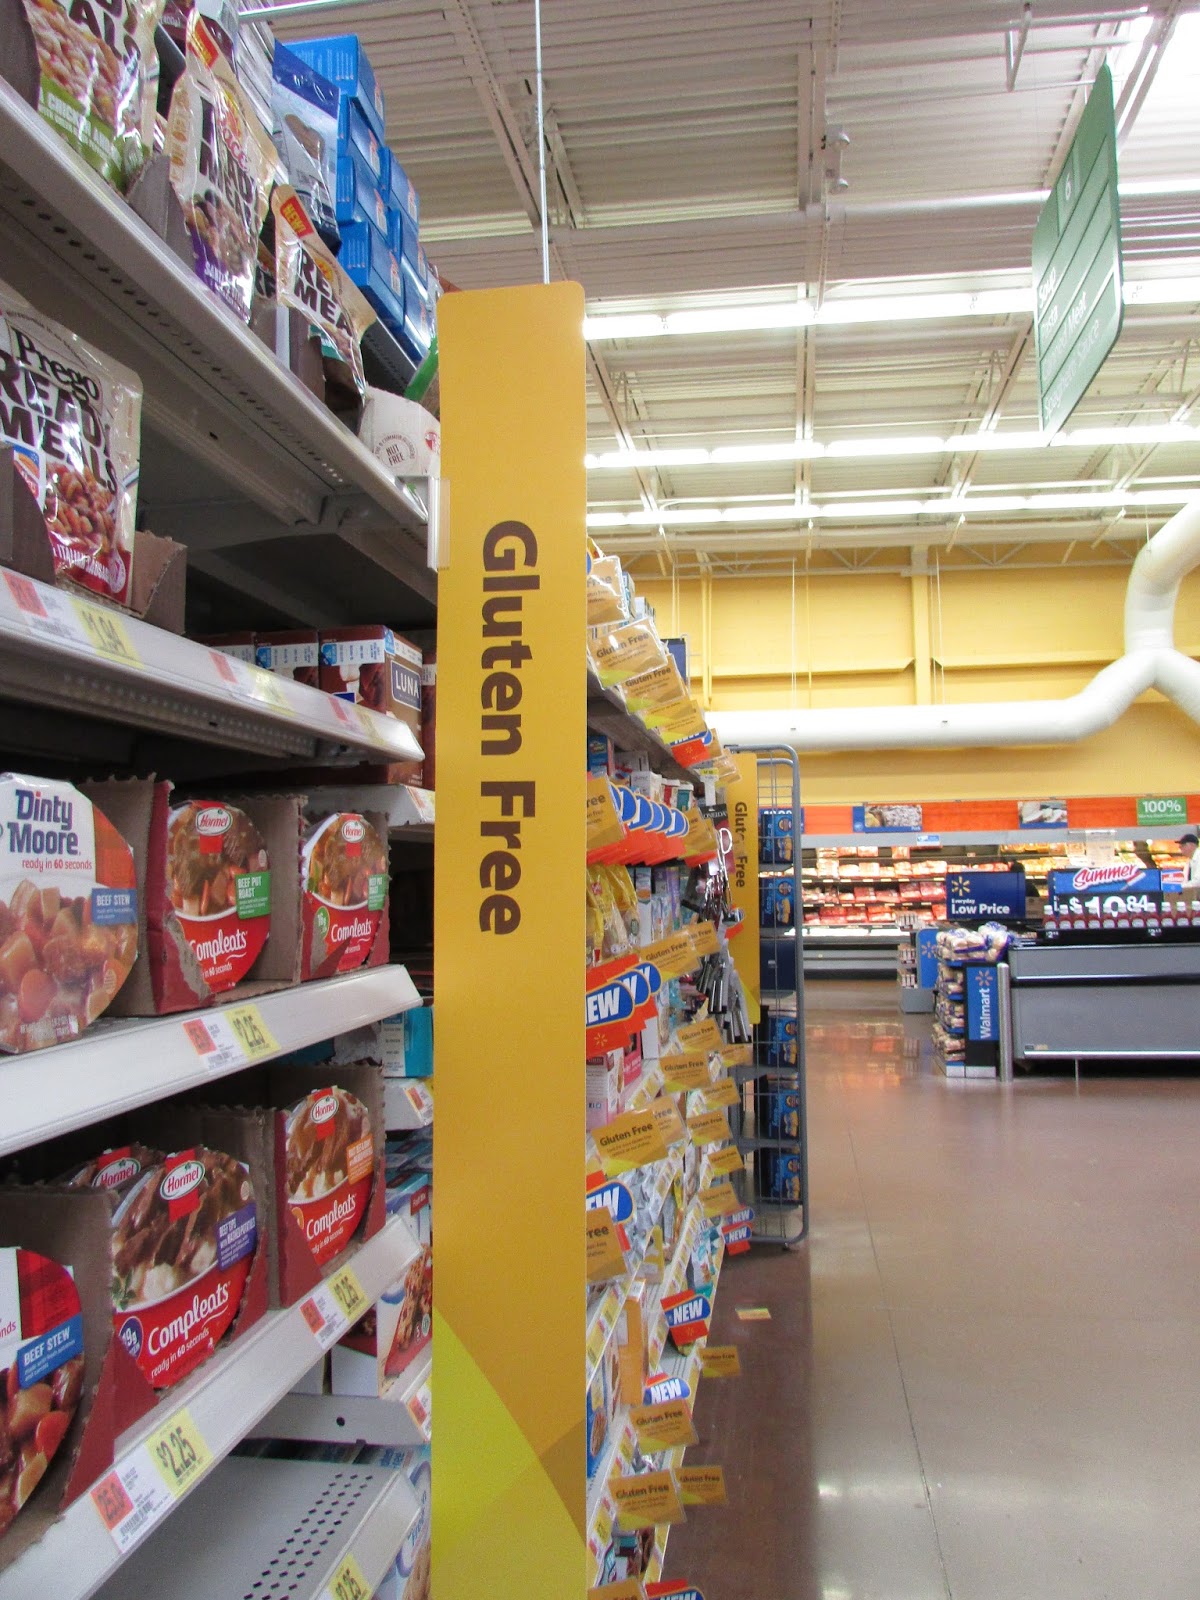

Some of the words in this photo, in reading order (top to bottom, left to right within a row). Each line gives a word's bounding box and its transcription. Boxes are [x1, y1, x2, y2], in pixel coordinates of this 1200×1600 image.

[1067, 291, 1087, 334] Meat
[10, 325, 101, 405] Prego
[385, 444, 400, 457] NUT
[388, 453, 405, 466] FREE
[481, 520, 540, 755] Gluten
[597, 640, 627, 659] Gluten
[628, 632, 649, 646] Free
[395, 670, 420, 699] LUNA
[625, 673, 653, 688] Gluten
[653, 666, 672, 680] Free
[15, 789, 73, 830] Dinty
[587, 793, 606, 808] ree
[1142, 800, 1182, 813] 100%
[199, 814, 229, 828] Hormel
[345, 825, 363, 838] Hormel
[735, 801, 748, 840] Glut
[7, 822, 79, 855] Moore
[22, 857, 44, 873] ready
[45, 857, 53, 869] in
[53, 858, 64, 869] 60
[65, 857, 93, 870] seconds
[479, 781, 536, 934] Free
[735, 856, 748, 888] Free
[1073, 863, 1140, 890] Summer
[96, 895, 112, 906] BEEF
[113, 894, 130, 906] STEW
[951, 904, 977, 914] Low
[979, 903, 1010, 914] Price
[645, 946, 671, 962] Gluten
[671, 940, 688, 953] Free
[216, 961, 233, 975] seconds
[587, 986, 620, 1025] EW
[980, 988, 991, 1039] Walmart
[664, 1060, 688, 1072] Gluten
[688, 1059, 705, 1069] Free
[315, 1101, 335, 1118] Hormel
[599, 1129, 631, 1147] Gluten
[631, 1122, 653, 1137] Free
[167, 1165, 200, 1193] Hormel
[587, 1186, 620, 1214] EW
[307, 1193, 357, 1240] Compleats
[732, 1210, 750, 1222] NEW
[587, 1225, 609, 1238] ree
[728, 1226, 748, 1243] NEW
[148, 1281, 231, 1356] Compleats
[673, 1299, 704, 1326] NEW
[24, 1341, 46, 1365] BEEF
[47, 1326, 71, 1351] STEW
[152, 1354, 170, 1378] ready
[170, 1352, 177, 1363] in
[177, 1344, 186, 1358] 60
[186, 1326, 210, 1350] seconds
[650, 1379, 682, 1403] NEW
[636, 1414, 663, 1426] Gluten
[664, 1409, 683, 1420] Free
[156, 1427, 198, 1479] $2.25
[616, 1487, 648, 1499] Gluten
[648, 1484, 669, 1493] Free
